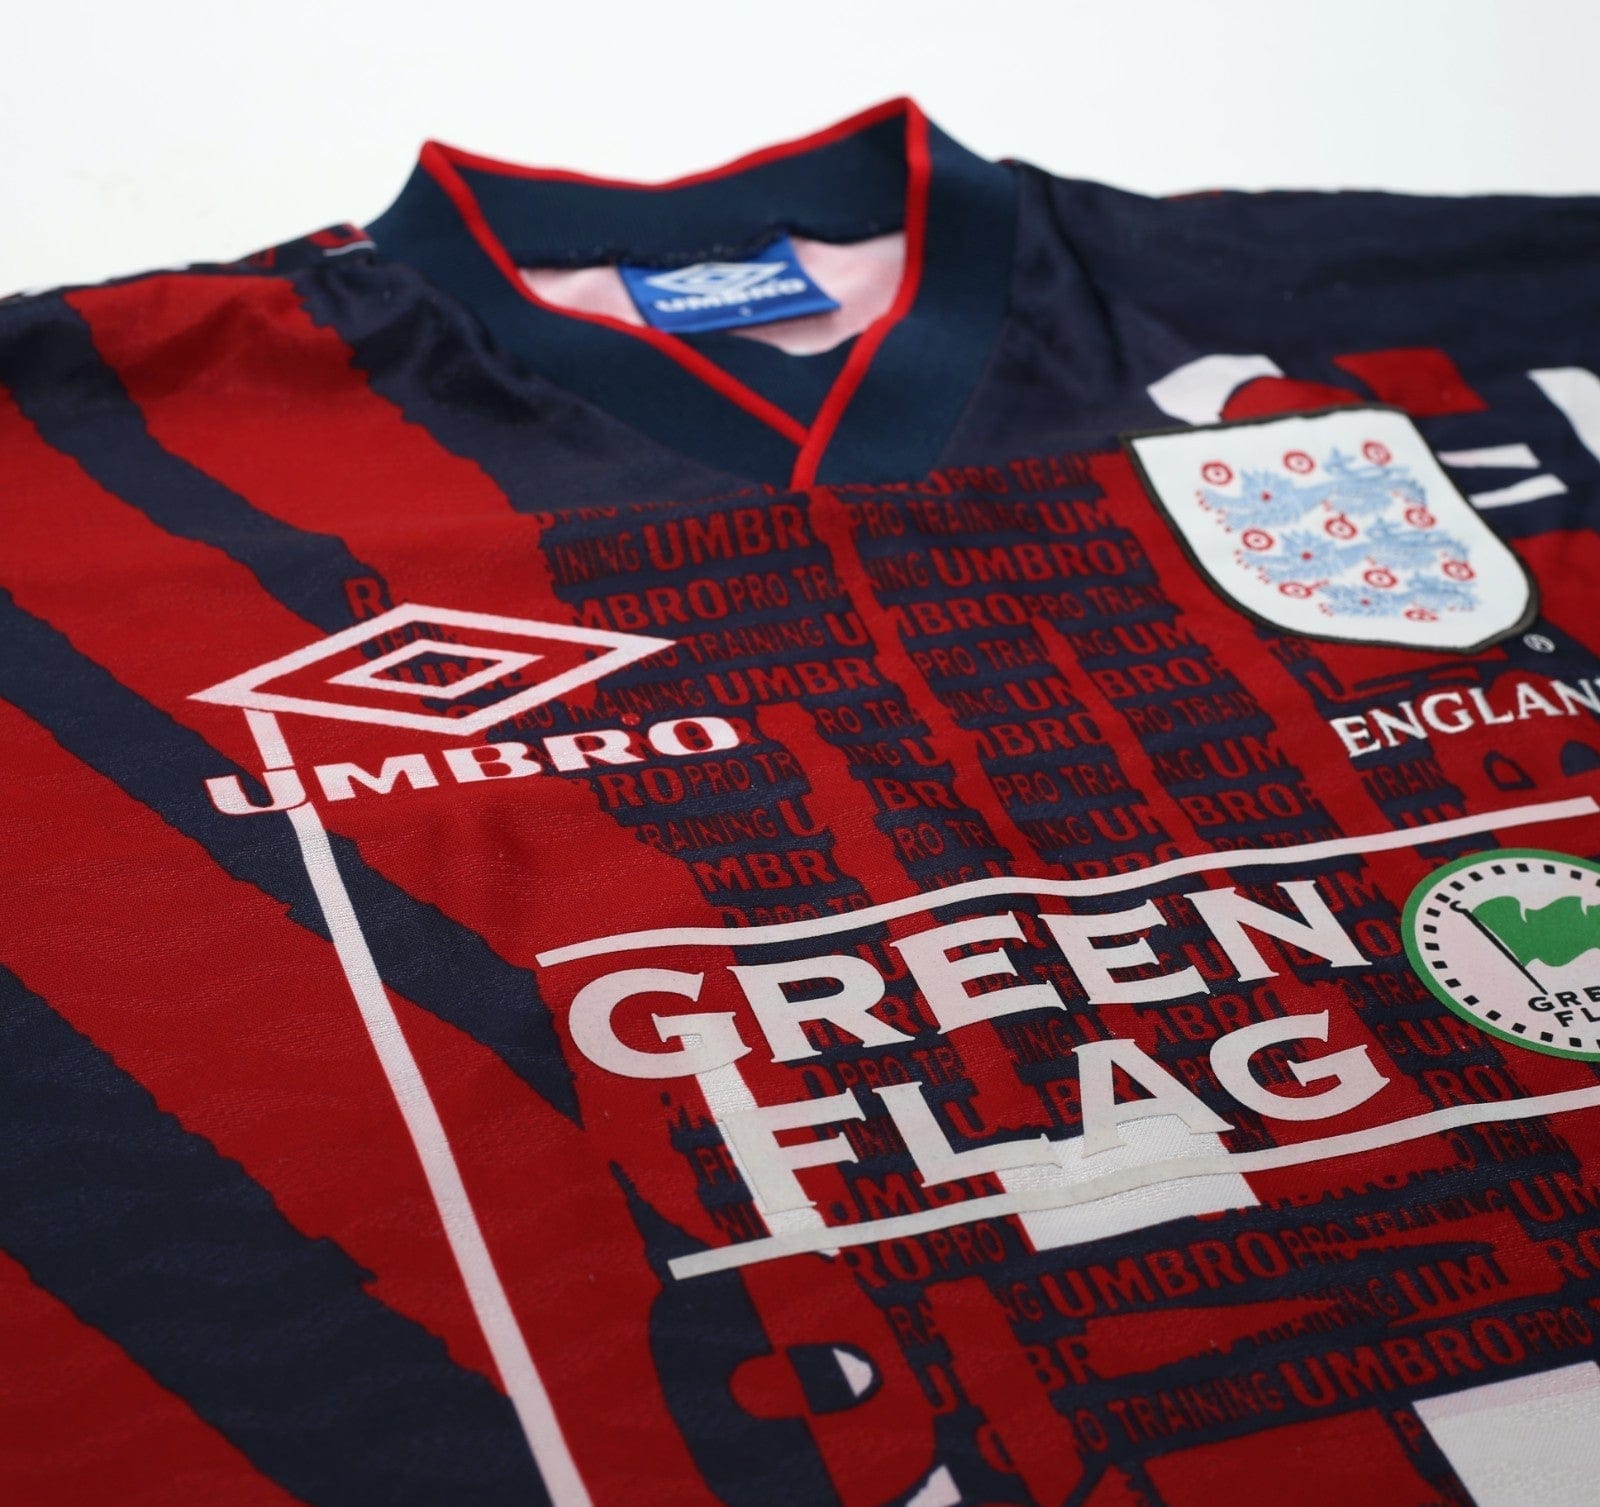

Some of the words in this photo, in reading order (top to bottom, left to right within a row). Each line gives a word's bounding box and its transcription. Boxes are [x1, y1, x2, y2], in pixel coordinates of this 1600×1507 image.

[725, 573, 790, 612] PRO
[930, 539, 1126, 587] UMBRO
[706, 656, 881, 708] UMBR
[1330, 675, 1600, 758] ENGLAN
[205, 716, 741, 816] UMBRO
[684, 757, 751, 797] PRO
[990, 770, 1062, 808] PRO
[569, 880, 1372, 1080] GREEN
[716, 1009, 1391, 1216] FLAG
[1038, 1230, 1290, 1319] UMBRO
[1279, 1317, 1526, 1408] UMBRO
[1514, 1304, 1594, 1354] PRO
